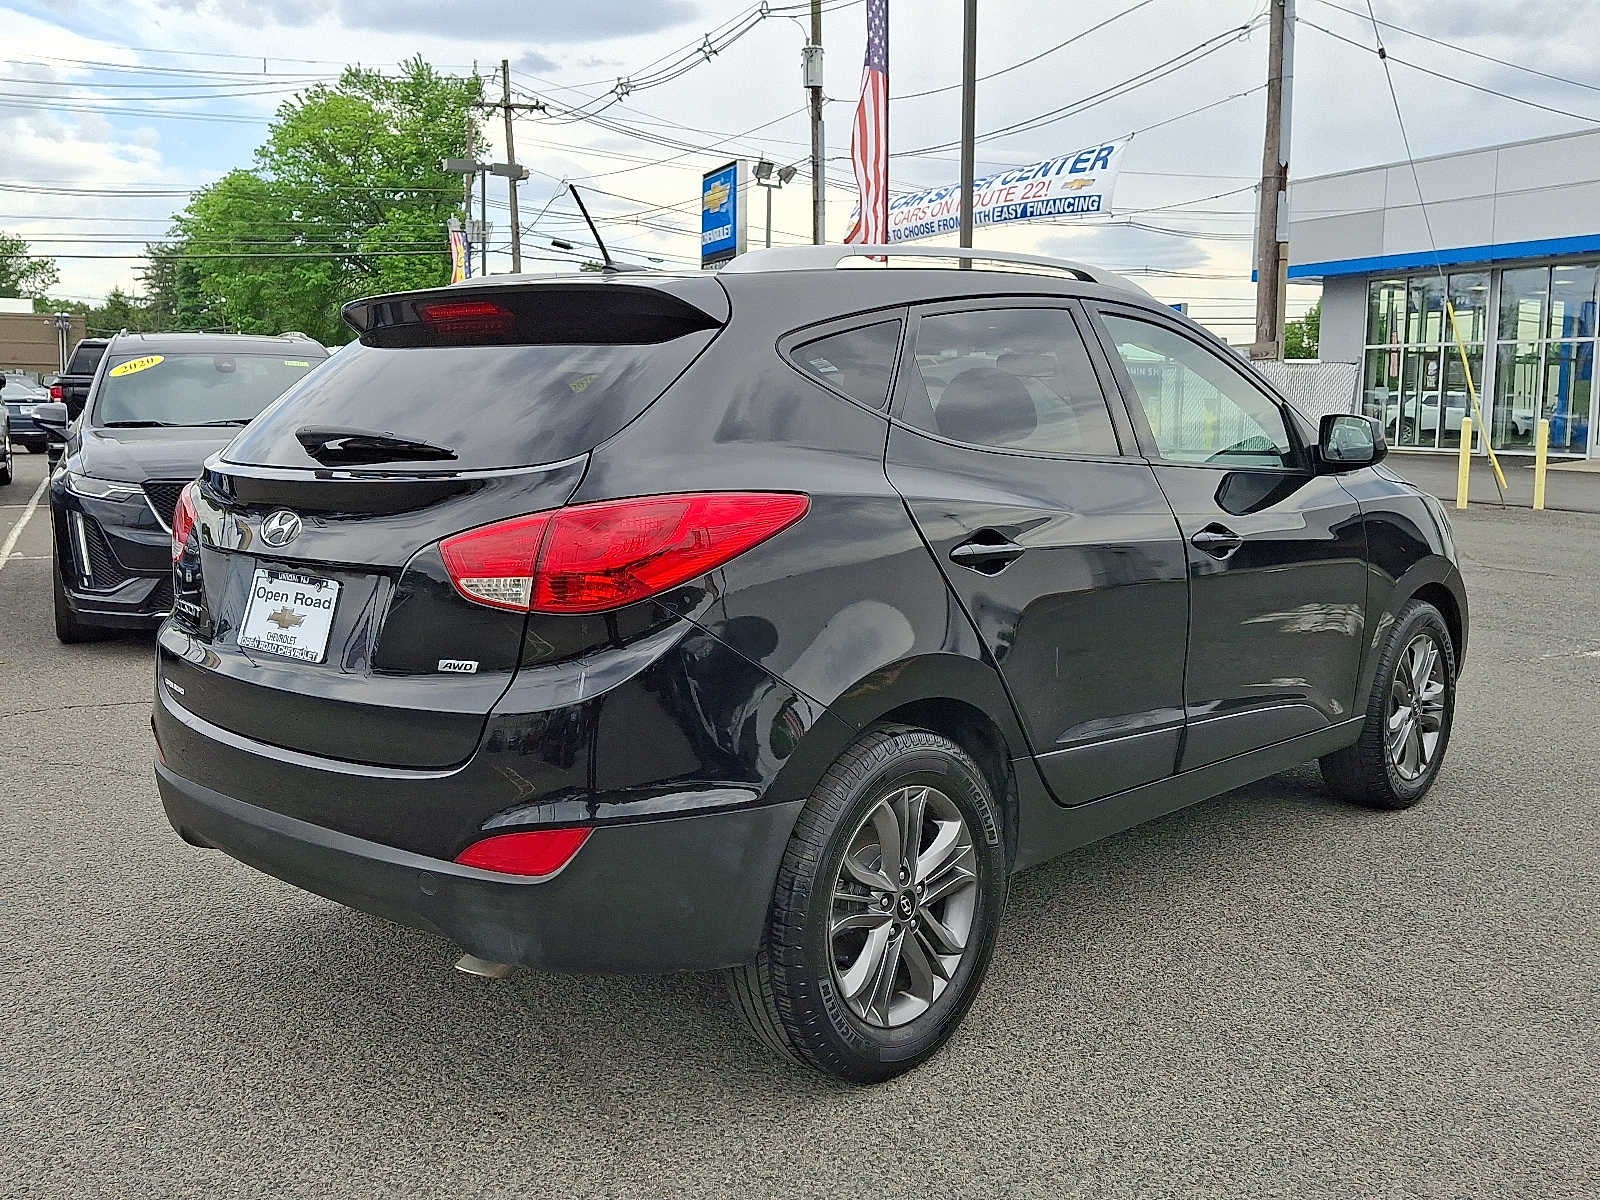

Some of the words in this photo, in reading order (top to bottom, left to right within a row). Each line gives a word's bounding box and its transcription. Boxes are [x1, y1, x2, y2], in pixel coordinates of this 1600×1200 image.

[1001, 145, 1114, 186] CENTER
[892, 227, 904, 241] TO
[903, 221, 936, 238] CHOOSE
[993, 204, 1025, 221] EASY
[1026, 195, 1099, 217] FINANCING
[894, 205, 930, 226] CARS
[931, 198, 954, 217] ON
[957, 185, 1019, 212] OUTE
[1021, 180, 1052, 200] 22!
[120, 357, 154, 374] 2020
[256, 586, 289, 603] Open
[293, 591, 333, 610] Road
[441, 661, 475, 672] AWD
